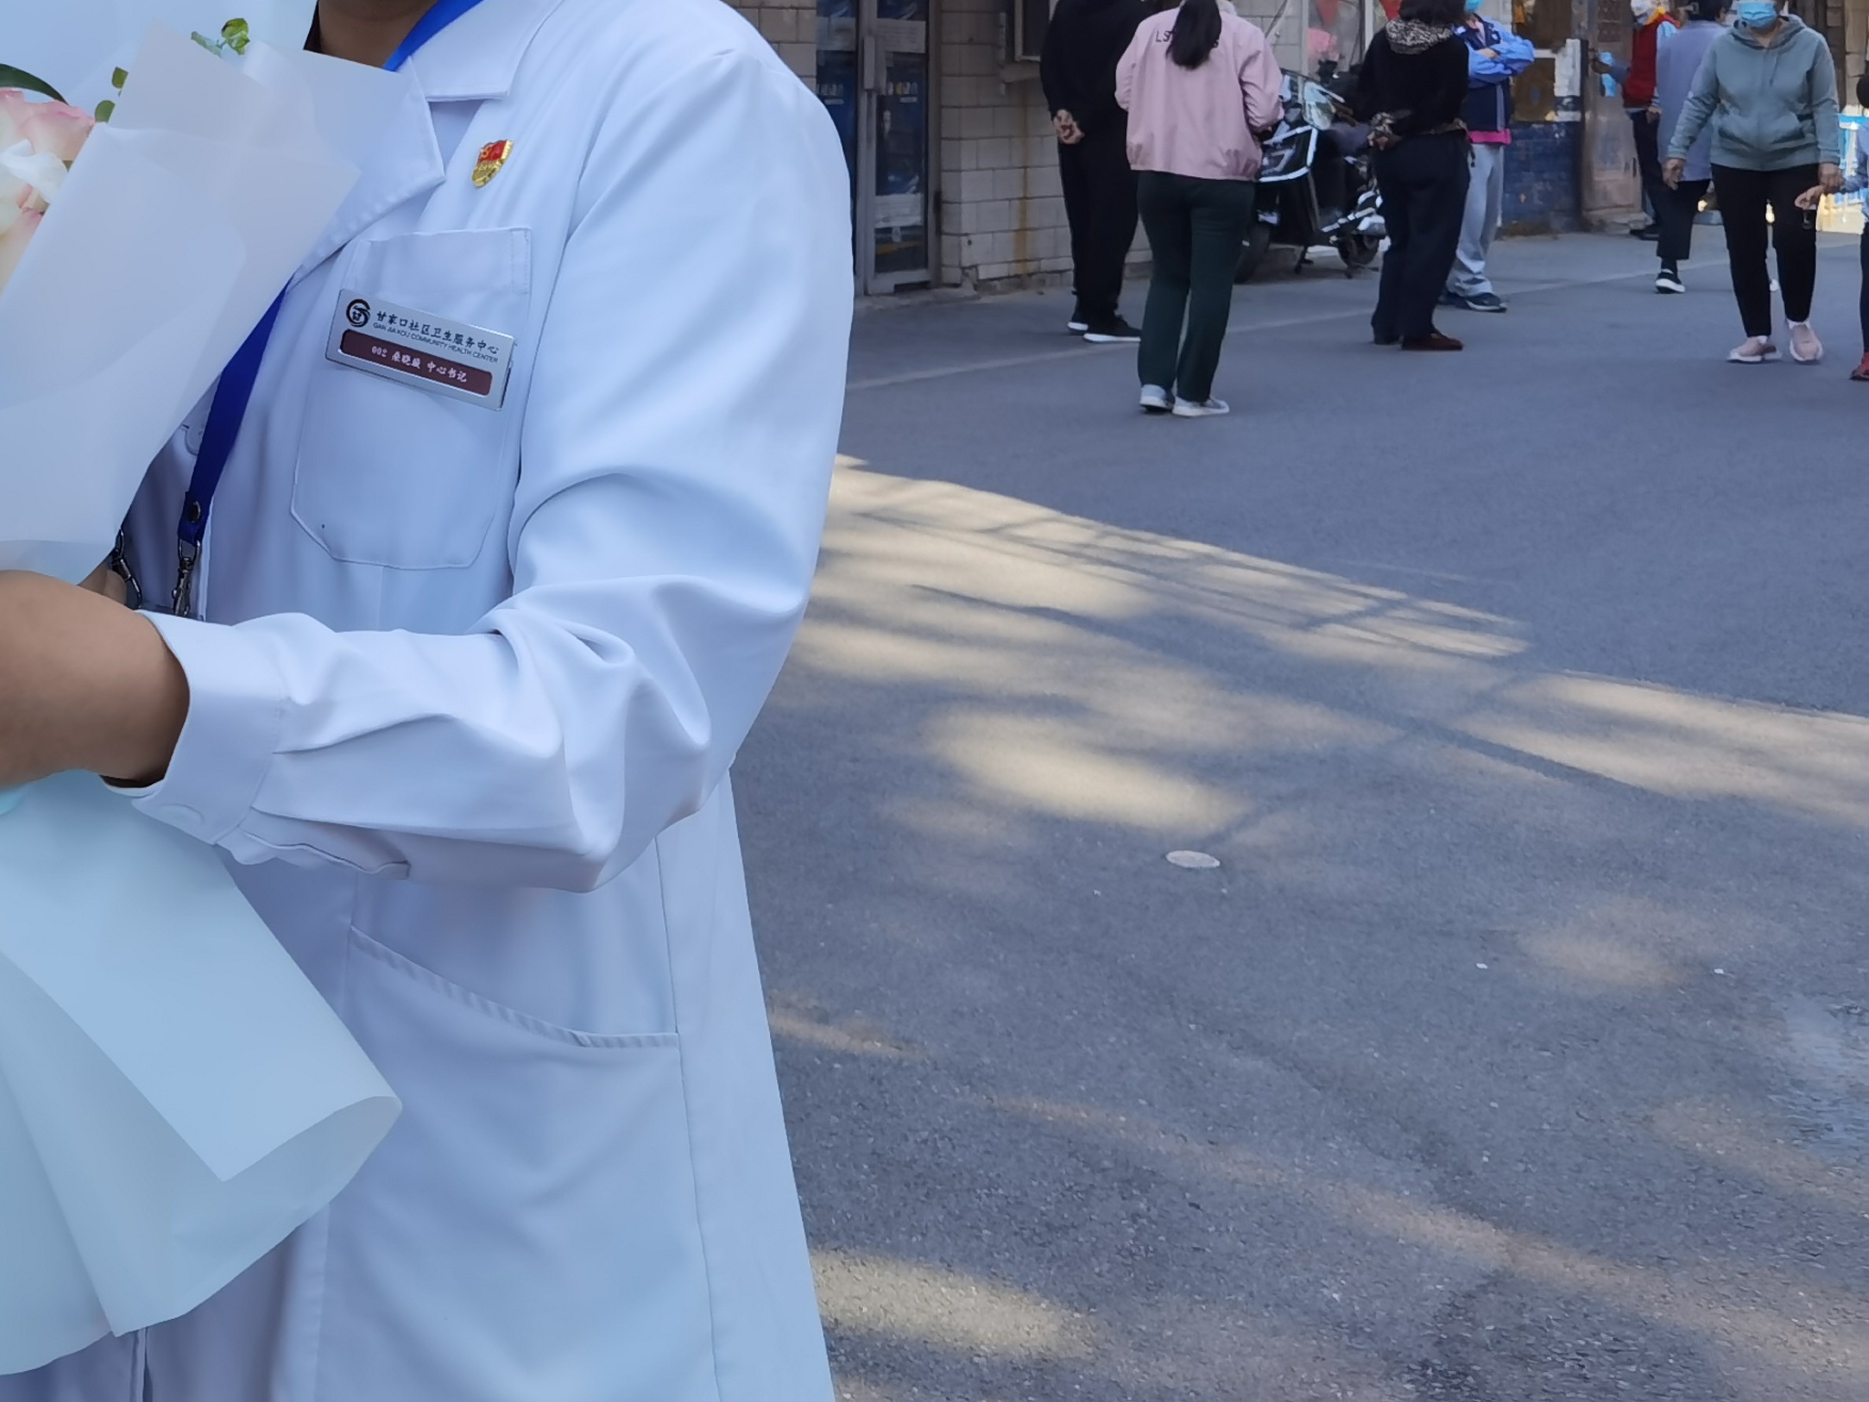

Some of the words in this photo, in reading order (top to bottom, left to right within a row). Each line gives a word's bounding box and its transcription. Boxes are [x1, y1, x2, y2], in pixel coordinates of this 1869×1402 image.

[376, 311, 499, 354] 甘家口社区卫生服务中心
[472, 350, 498, 363] CENTER
